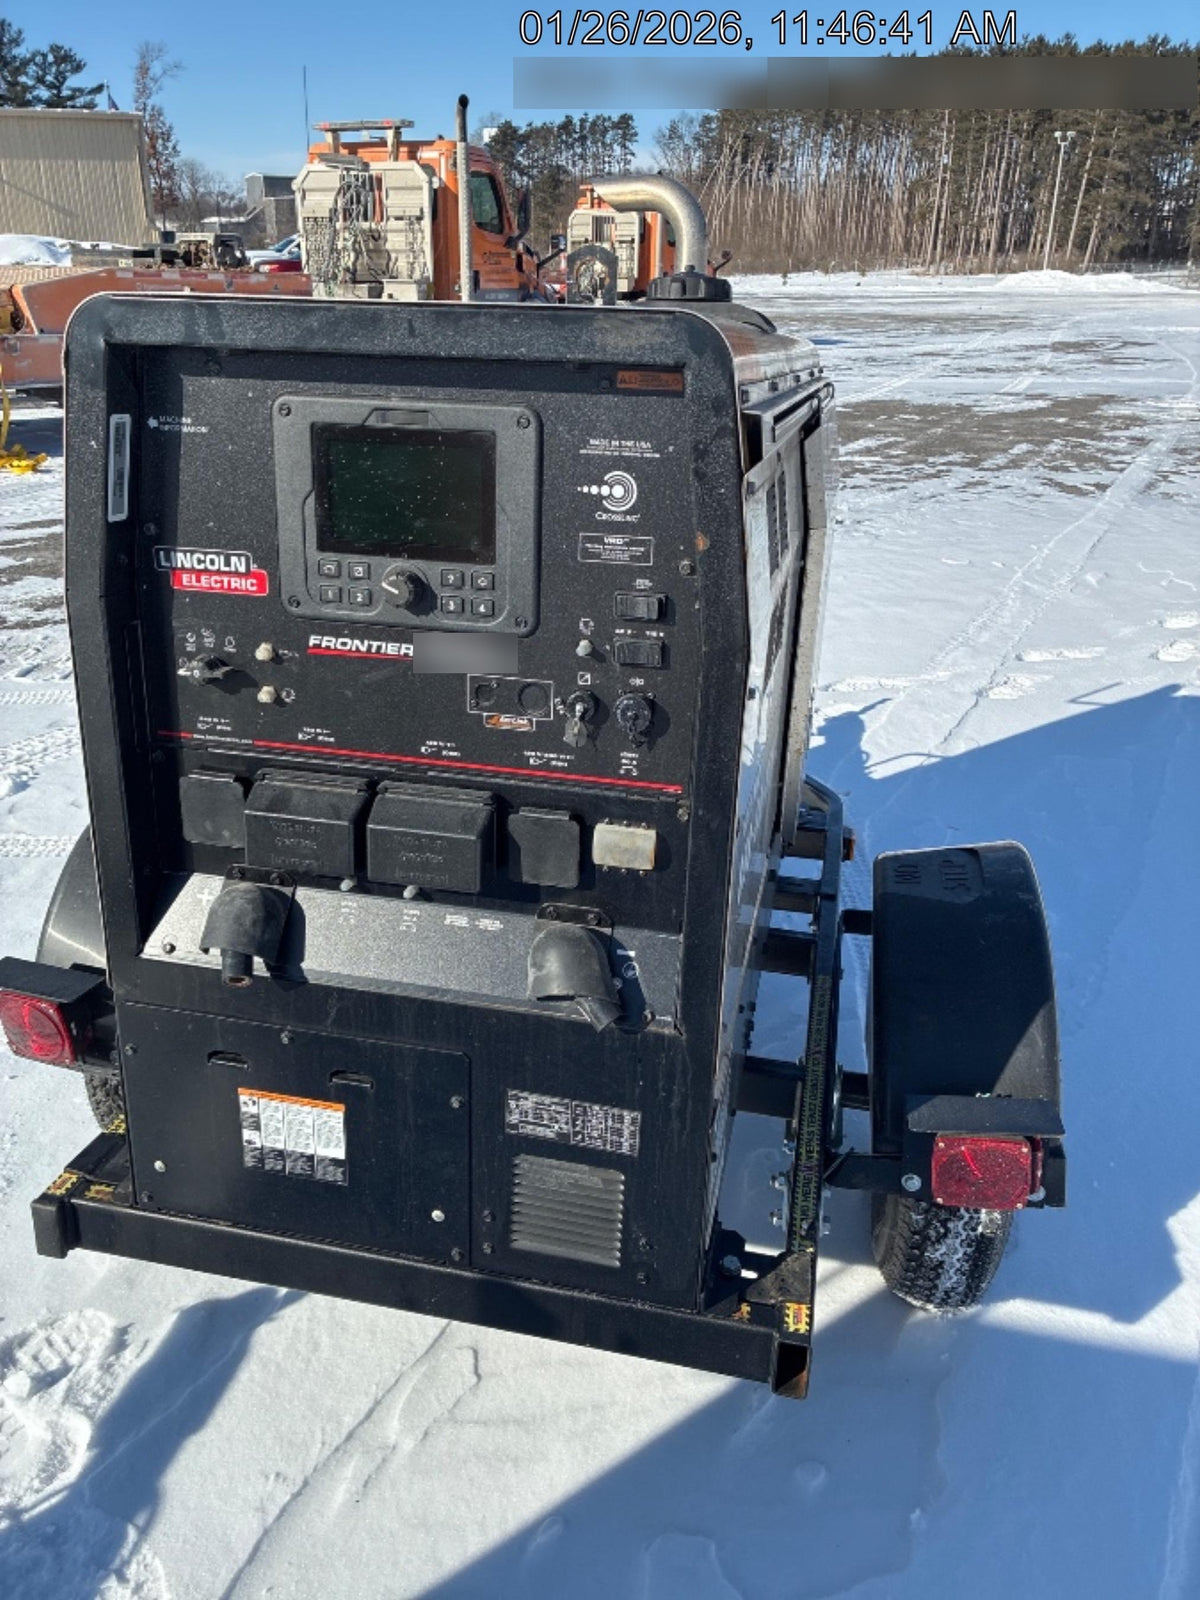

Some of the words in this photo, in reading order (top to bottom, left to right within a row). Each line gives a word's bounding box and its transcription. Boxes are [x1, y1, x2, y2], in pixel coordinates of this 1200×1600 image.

[159, 550, 246, 573] LINCOLN
[182, 573, 258, 592] ELECTRIC
[309, 635, 414, 656] FRONTIER
